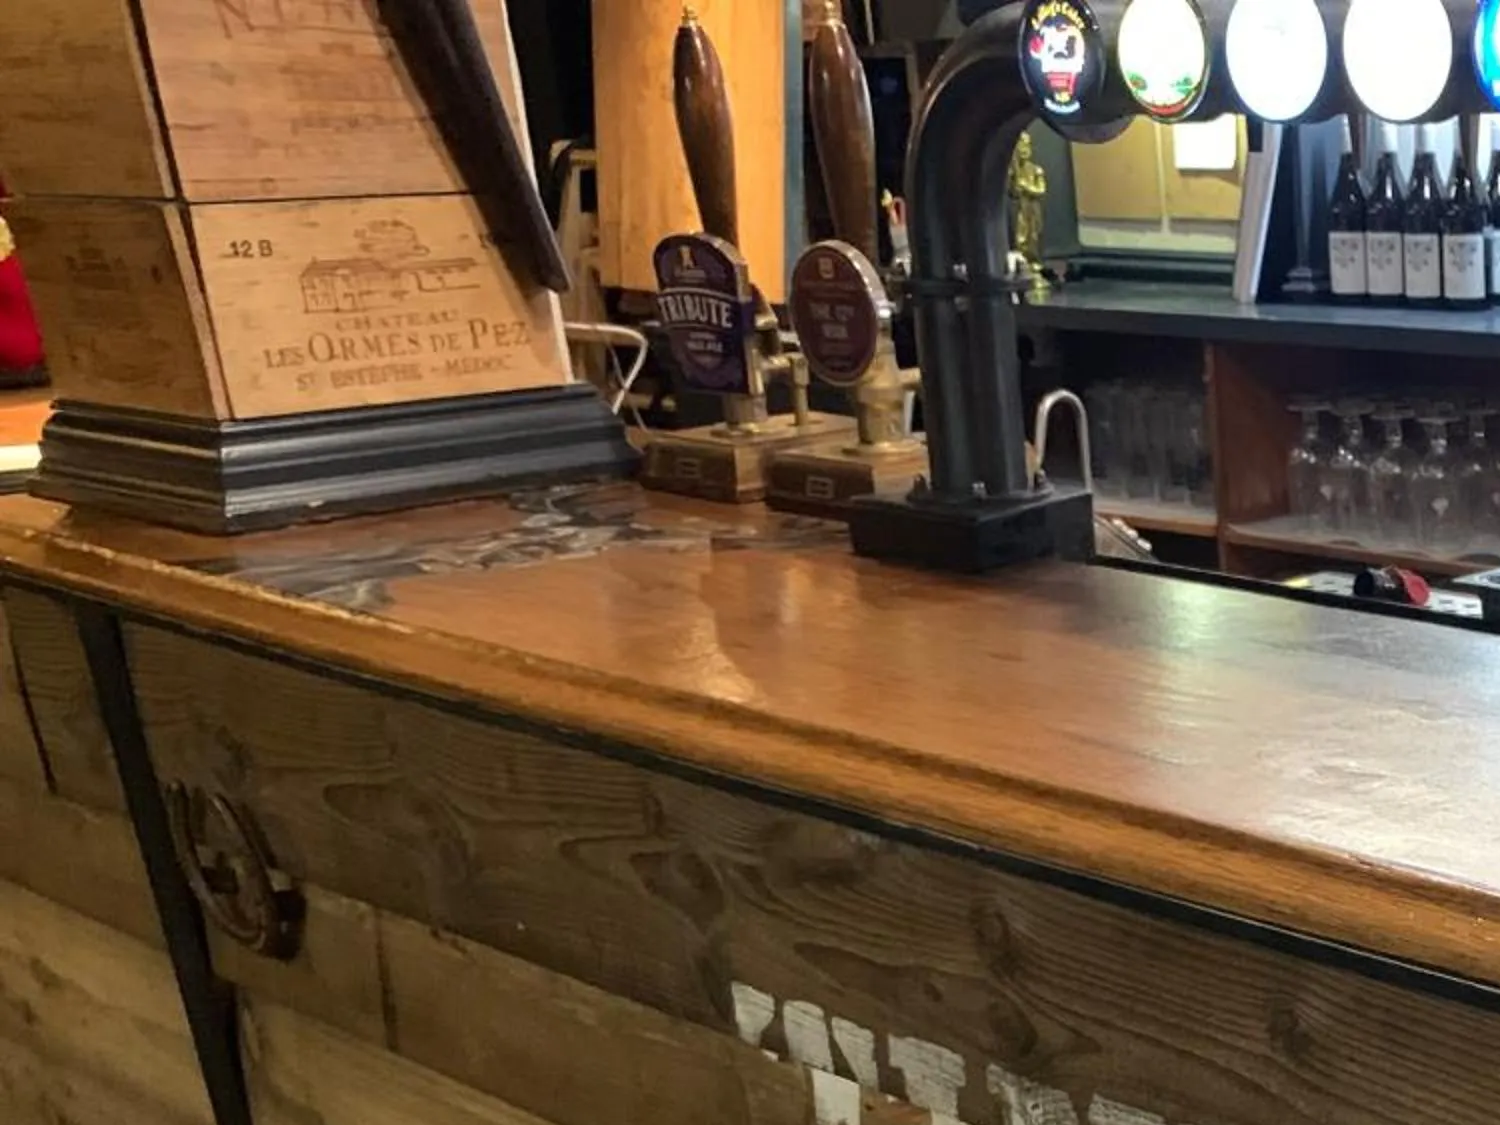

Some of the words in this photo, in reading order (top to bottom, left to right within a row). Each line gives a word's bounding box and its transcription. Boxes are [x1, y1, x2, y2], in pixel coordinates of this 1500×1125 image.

[657, 292, 733, 329] TRIBUTE
[262, 346, 304, 370] LES
[307, 330, 420, 364] ORMES
[430, 330, 463, 353] DE
[468, 316, 532, 350] PEZ
